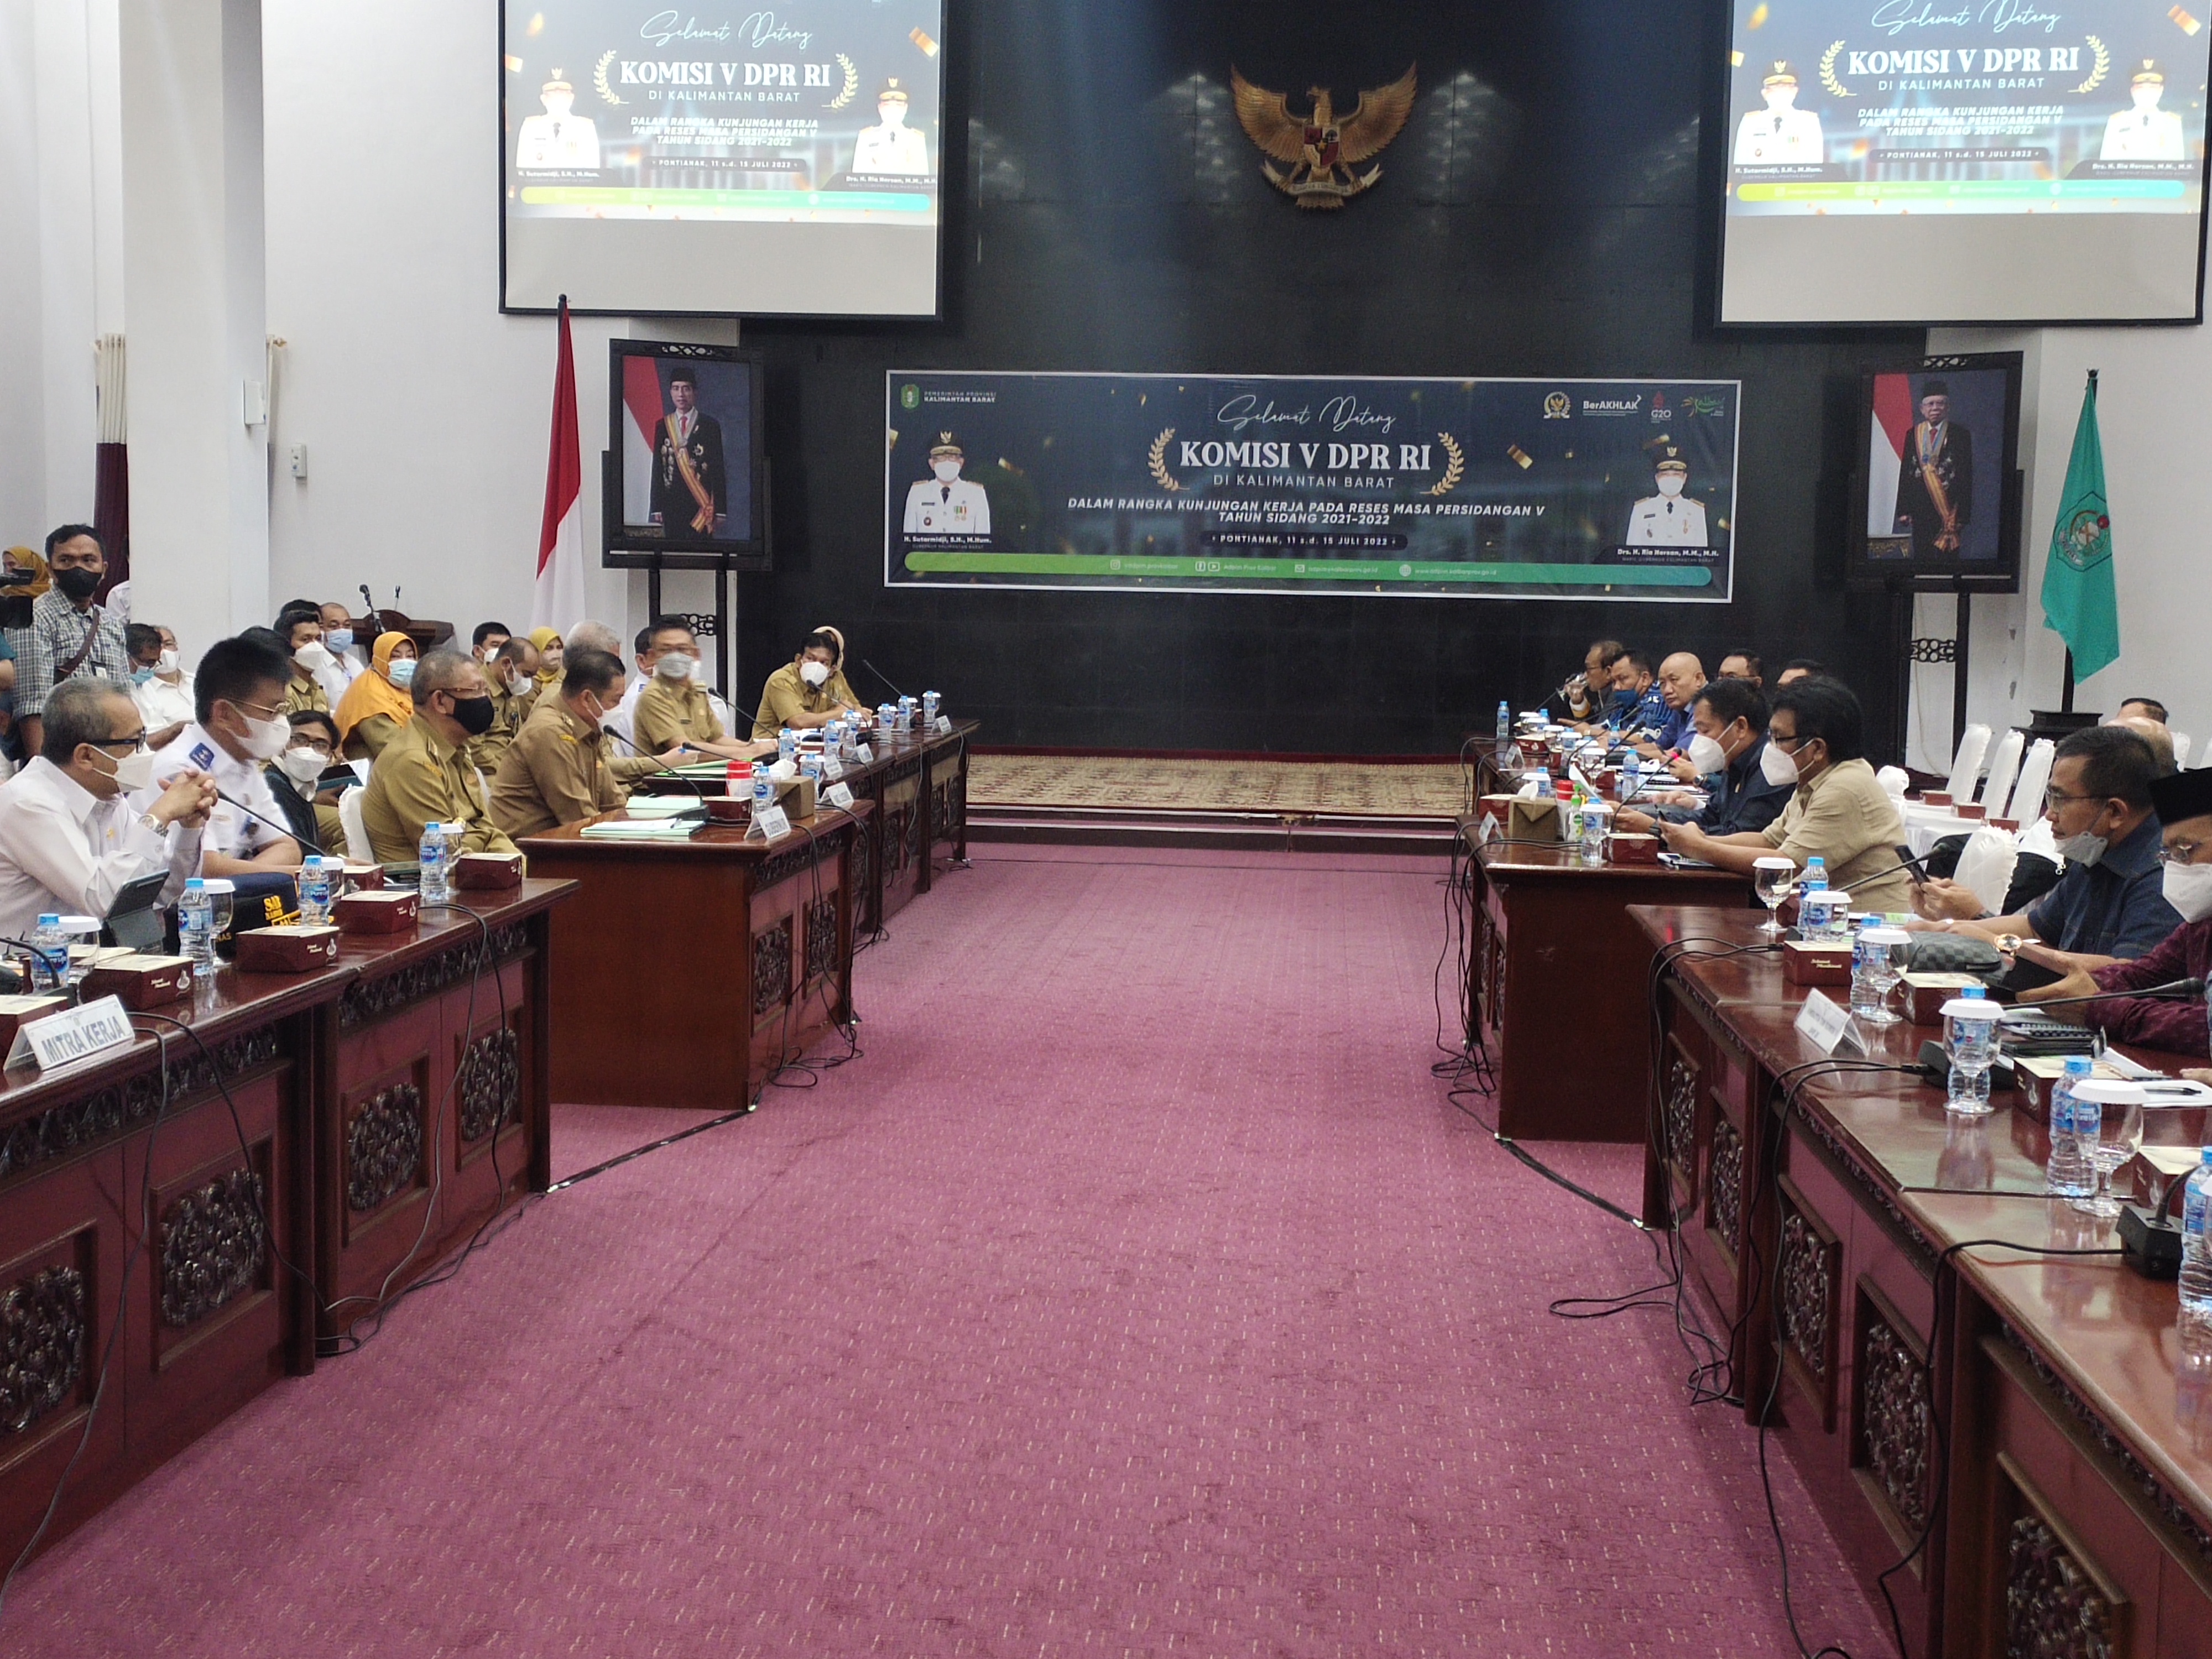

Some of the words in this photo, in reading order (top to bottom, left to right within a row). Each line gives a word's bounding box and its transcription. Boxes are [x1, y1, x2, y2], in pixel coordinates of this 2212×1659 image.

[1871, 0, 1970, 35] Selamat
[1978, 0, 2061, 33] Datang
[640, 10, 731, 46] Selamat
[738, 11, 812, 50] Datang
[1848, 50, 1950, 74] KOMISI
[1958, 49, 1976, 74] V
[1983, 48, 2041, 72] DPR
[2048, 47, 2080, 71] RI
[620, 61, 713, 85] KOMISI
[720, 63, 738, 85] V
[744, 63, 796, 86] DPR
[803, 64, 831, 87] RI
[1879, 81, 1892, 91] DI
[1900, 79, 1991, 90] KALIMANTAN
[1999, 78, 2044, 88] BARAT
[649, 90, 661, 100] DI
[668, 91, 752, 101] KALIMANTAN
[758, 92, 800, 102] BARAT
[1858, 108, 1898, 118] DALAM
[1901, 108, 1949, 117] RANGKA
[1953, 107, 2024, 117] KUNJUNGAN
[2027, 106, 2063, 115] KERJA
[630, 117, 667, 126] DALAM
[670, 117, 715, 127] RANGKA
[718, 118, 782, 128] KUNJUNGAN
[785, 119, 818, 128] KERJA
[1859, 118, 1891, 127] PADA
[1894, 117, 1928, 127] RESES
[1932, 117, 1965, 126] MASA
[1968, 116, 2049, 125] PERSIDANGAN
[2054, 116, 2062, 124] V
[632, 126, 661, 135] PADA
[664, 127, 696, 135] RESES
[699, 127, 729, 136] MASA
[732, 128, 807, 137] PERSIDANGAN
[810, 129, 817, 137] V
[1886, 127, 1923, 136] TAHUN
[1927, 126, 1970, 135] SIDANG
[1974, 126, 2033, 135] 2021-2022
[657, 135, 691, 145] TAHUN
[694, 136, 735, 145] SIDANG
[738, 137, 792, 147] 2021-2022
[1583, 399, 1639, 410] BerAKHLAK
[1217, 394, 1311, 431] Selamat
[1319, 396, 1396, 434] Datang
[1651, 410, 1671, 418] G20
[1180, 441, 1291, 468] KOMISI
[1298, 443, 1319, 468] V
[1328, 444, 1390, 469] DPR
[1399, 445, 1432, 470] RI
[1213, 474, 1229, 486] DI
[1237, 474, 1337, 487] KALIMANTAN
[1345, 476, 1394, 489] BARAT
[1068, 498, 1113, 509] DALAM
[1117, 499, 1172, 510] RANGKA
[1177, 500, 1259, 512] KUNJUNGAN
[1263, 502, 1304, 512] KERJA
[1309, 503, 1343, 513] PADA
[1348, 503, 1389, 514] RESES
[1393, 504, 1431, 515] MASA
[1436, 504, 1531, 516] PERSIDANGAN
[1536, 506, 1546, 516] V
[1219, 512, 1261, 523] TAHUN
[1266, 513, 1317, 524] SIDANG
[1322, 514, 1390, 524] 2021-2022
[1219, 535, 1282, 545] PONTIANAK,
[1300, 536, 1318, 545] s.d.
[1338, 537, 1359, 545] JULI
[1363, 537, 1387, 546] 2022
[41, 1030, 87, 1063] MITRA
[81, 1016, 126, 1048] KERJA
